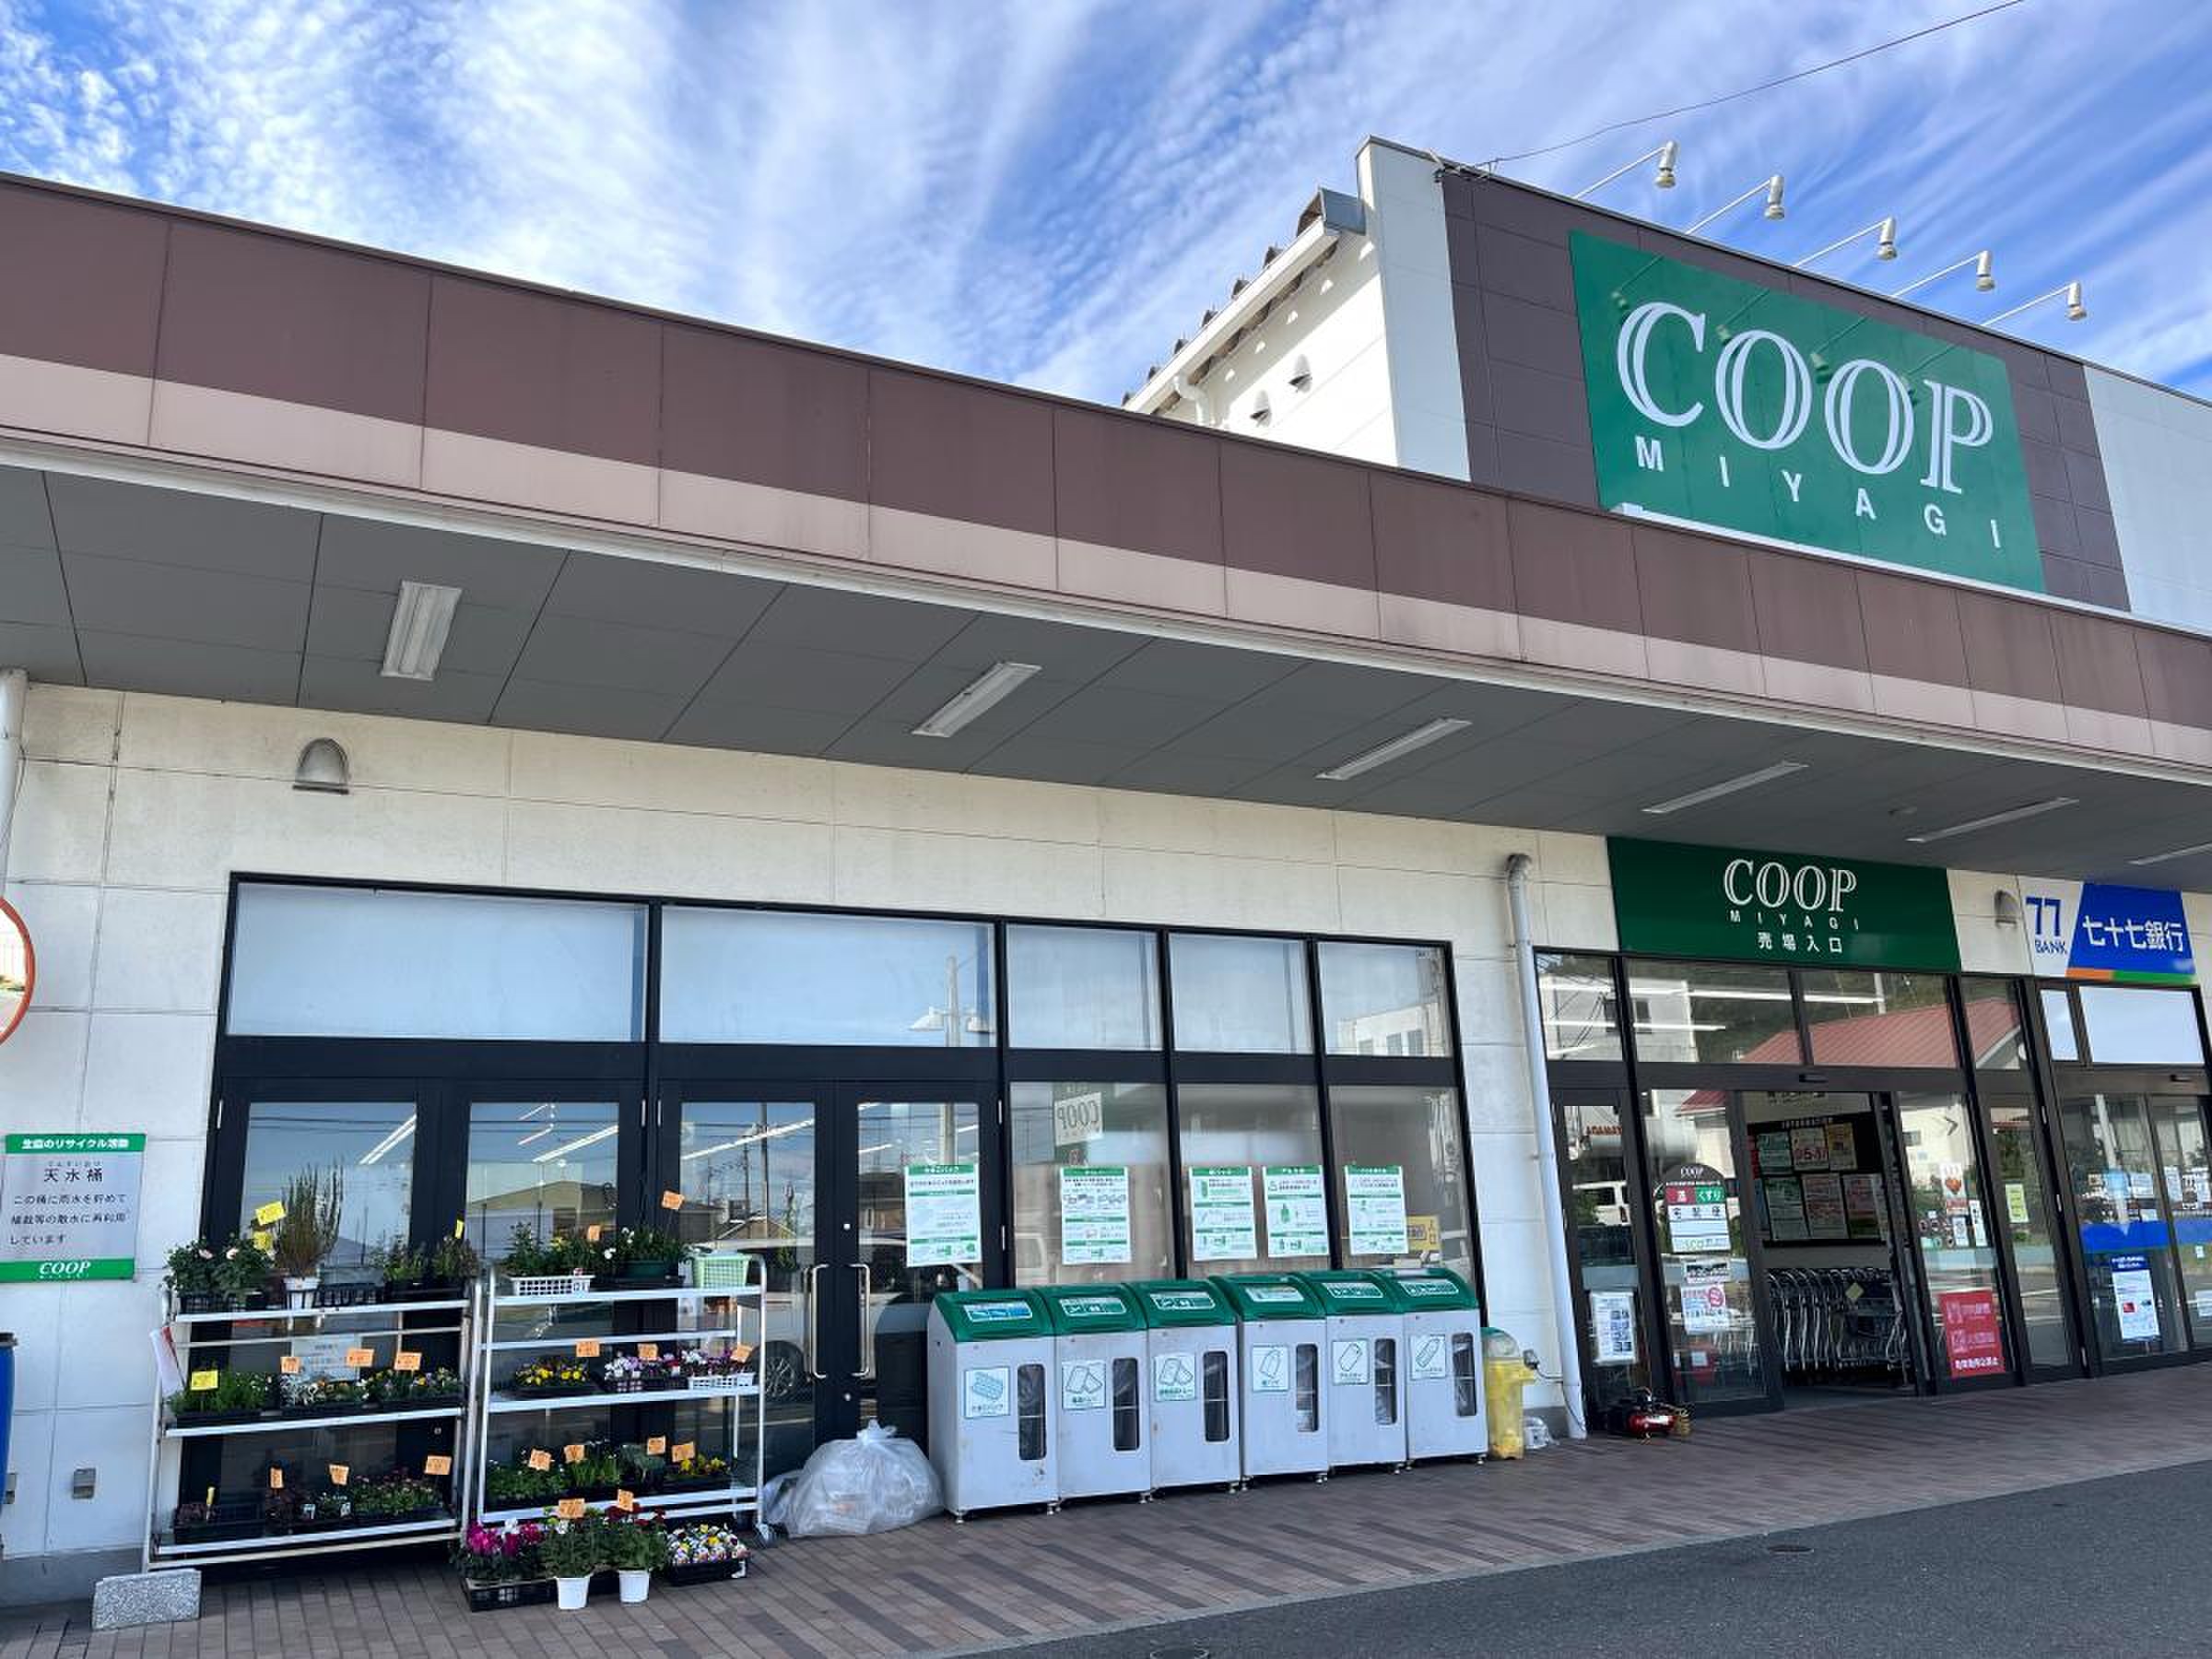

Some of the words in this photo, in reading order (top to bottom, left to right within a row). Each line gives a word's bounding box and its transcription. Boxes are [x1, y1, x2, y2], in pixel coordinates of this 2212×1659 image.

[1617, 301, 1994, 494] COOP
[1635, 436, 2001, 548] MIYAGI
[1724, 858, 1857, 912] COOP
[1730, 910, 1860, 931] MIYAGI
[2026, 897, 2063, 938] 77
[1758, 933, 1843, 954] 売場入口
[2035, 938, 2068, 957] BANK
[2082, 916, 2185, 953] 七十七銀行
[44, 1168, 103, 1182] 天水桶
[40, 1261, 91, 1276] COOP
